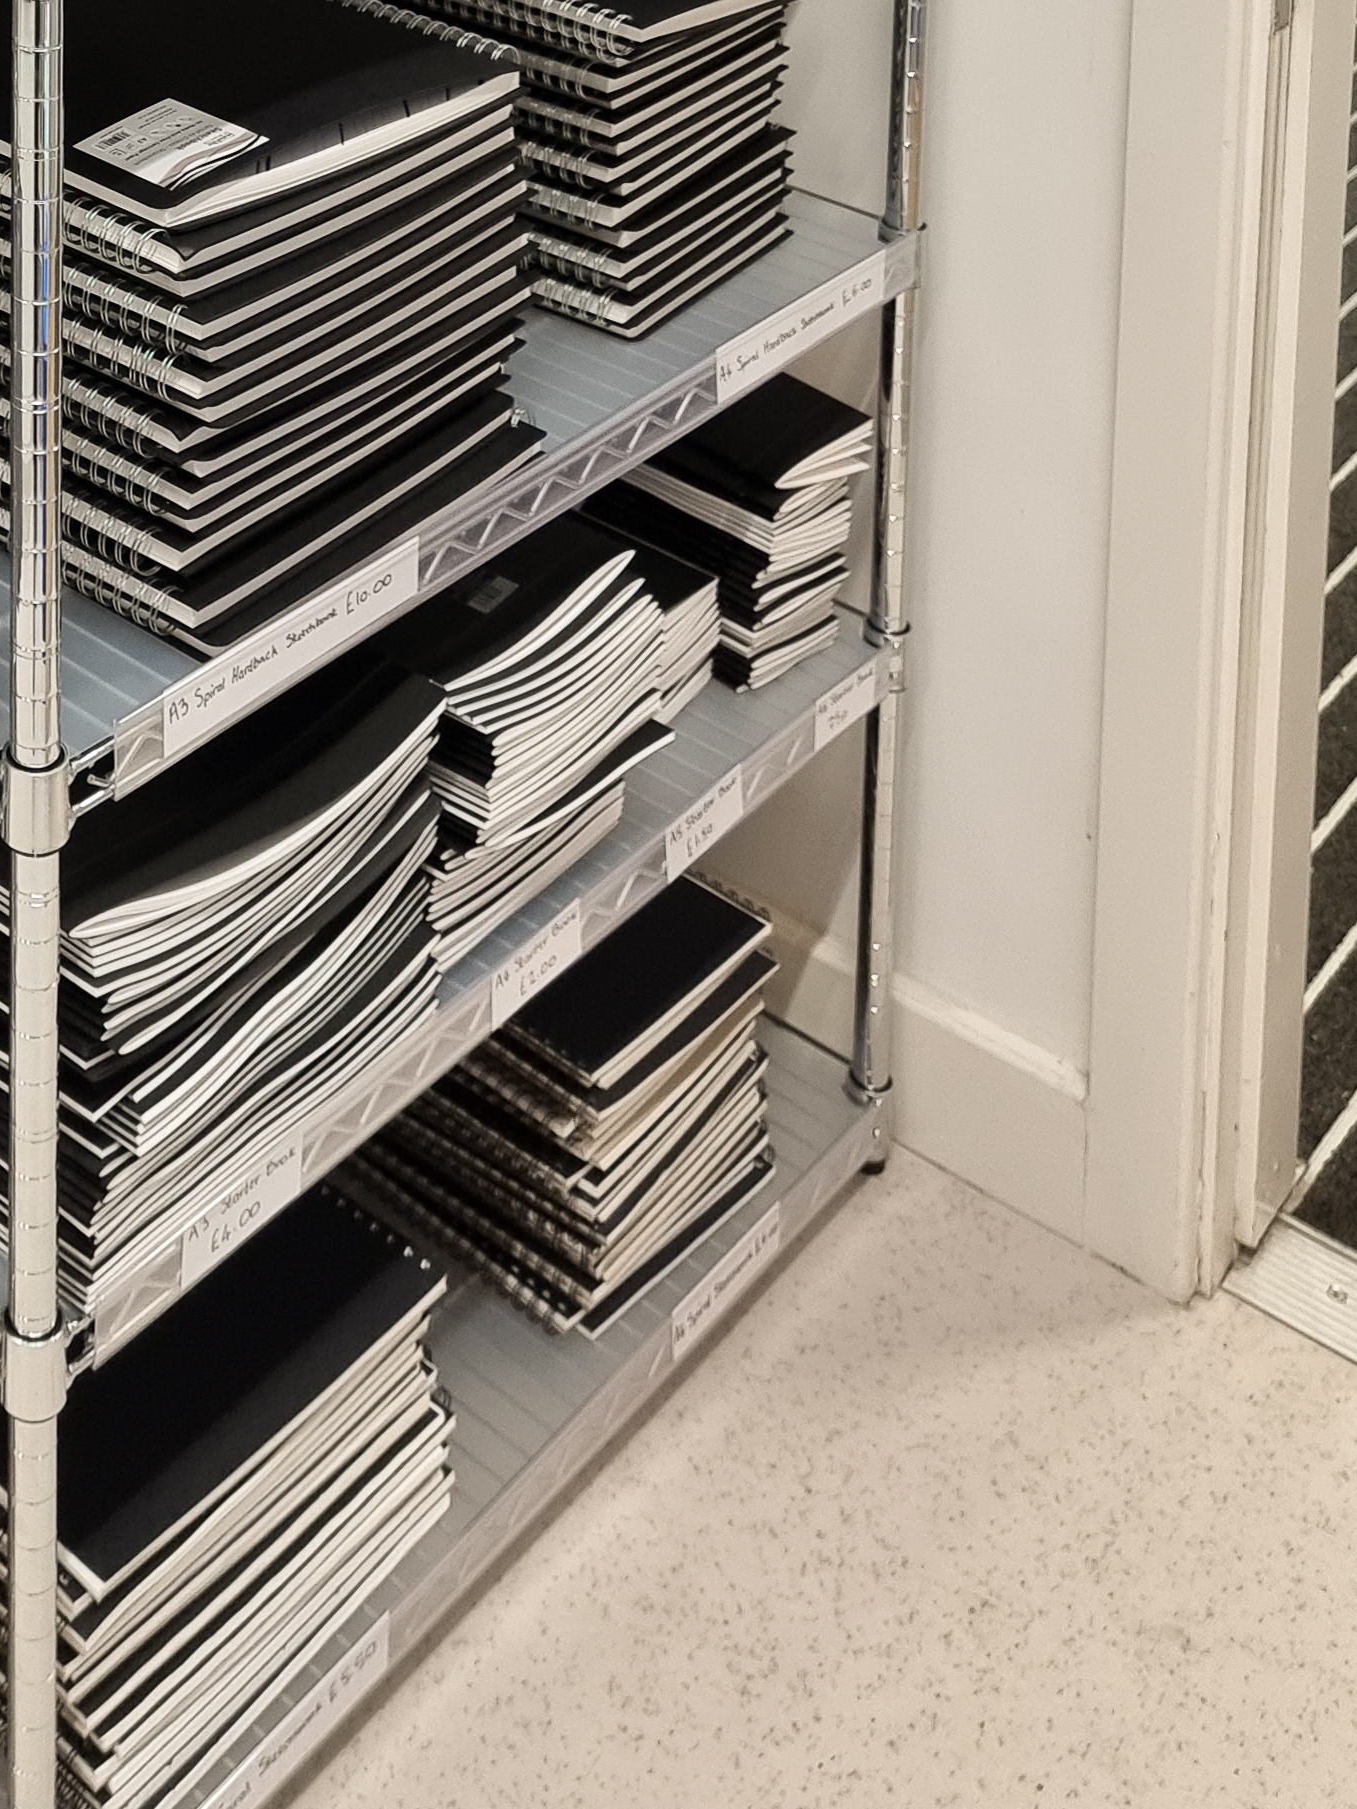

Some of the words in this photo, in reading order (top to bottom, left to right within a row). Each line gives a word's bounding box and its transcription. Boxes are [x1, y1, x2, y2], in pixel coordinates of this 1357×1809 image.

[168, 697, 190, 725] A3
[194, 677, 226, 710] Spiral
[231, 644, 279, 684] Hardback
[345, 573, 393, 617] £10.00
[187, 1217, 211, 1242] A3
[220, 1174, 261, 1216] Starter
[266, 1145, 297, 1178] Book
[210, 1200, 262, 1254] £4.00
